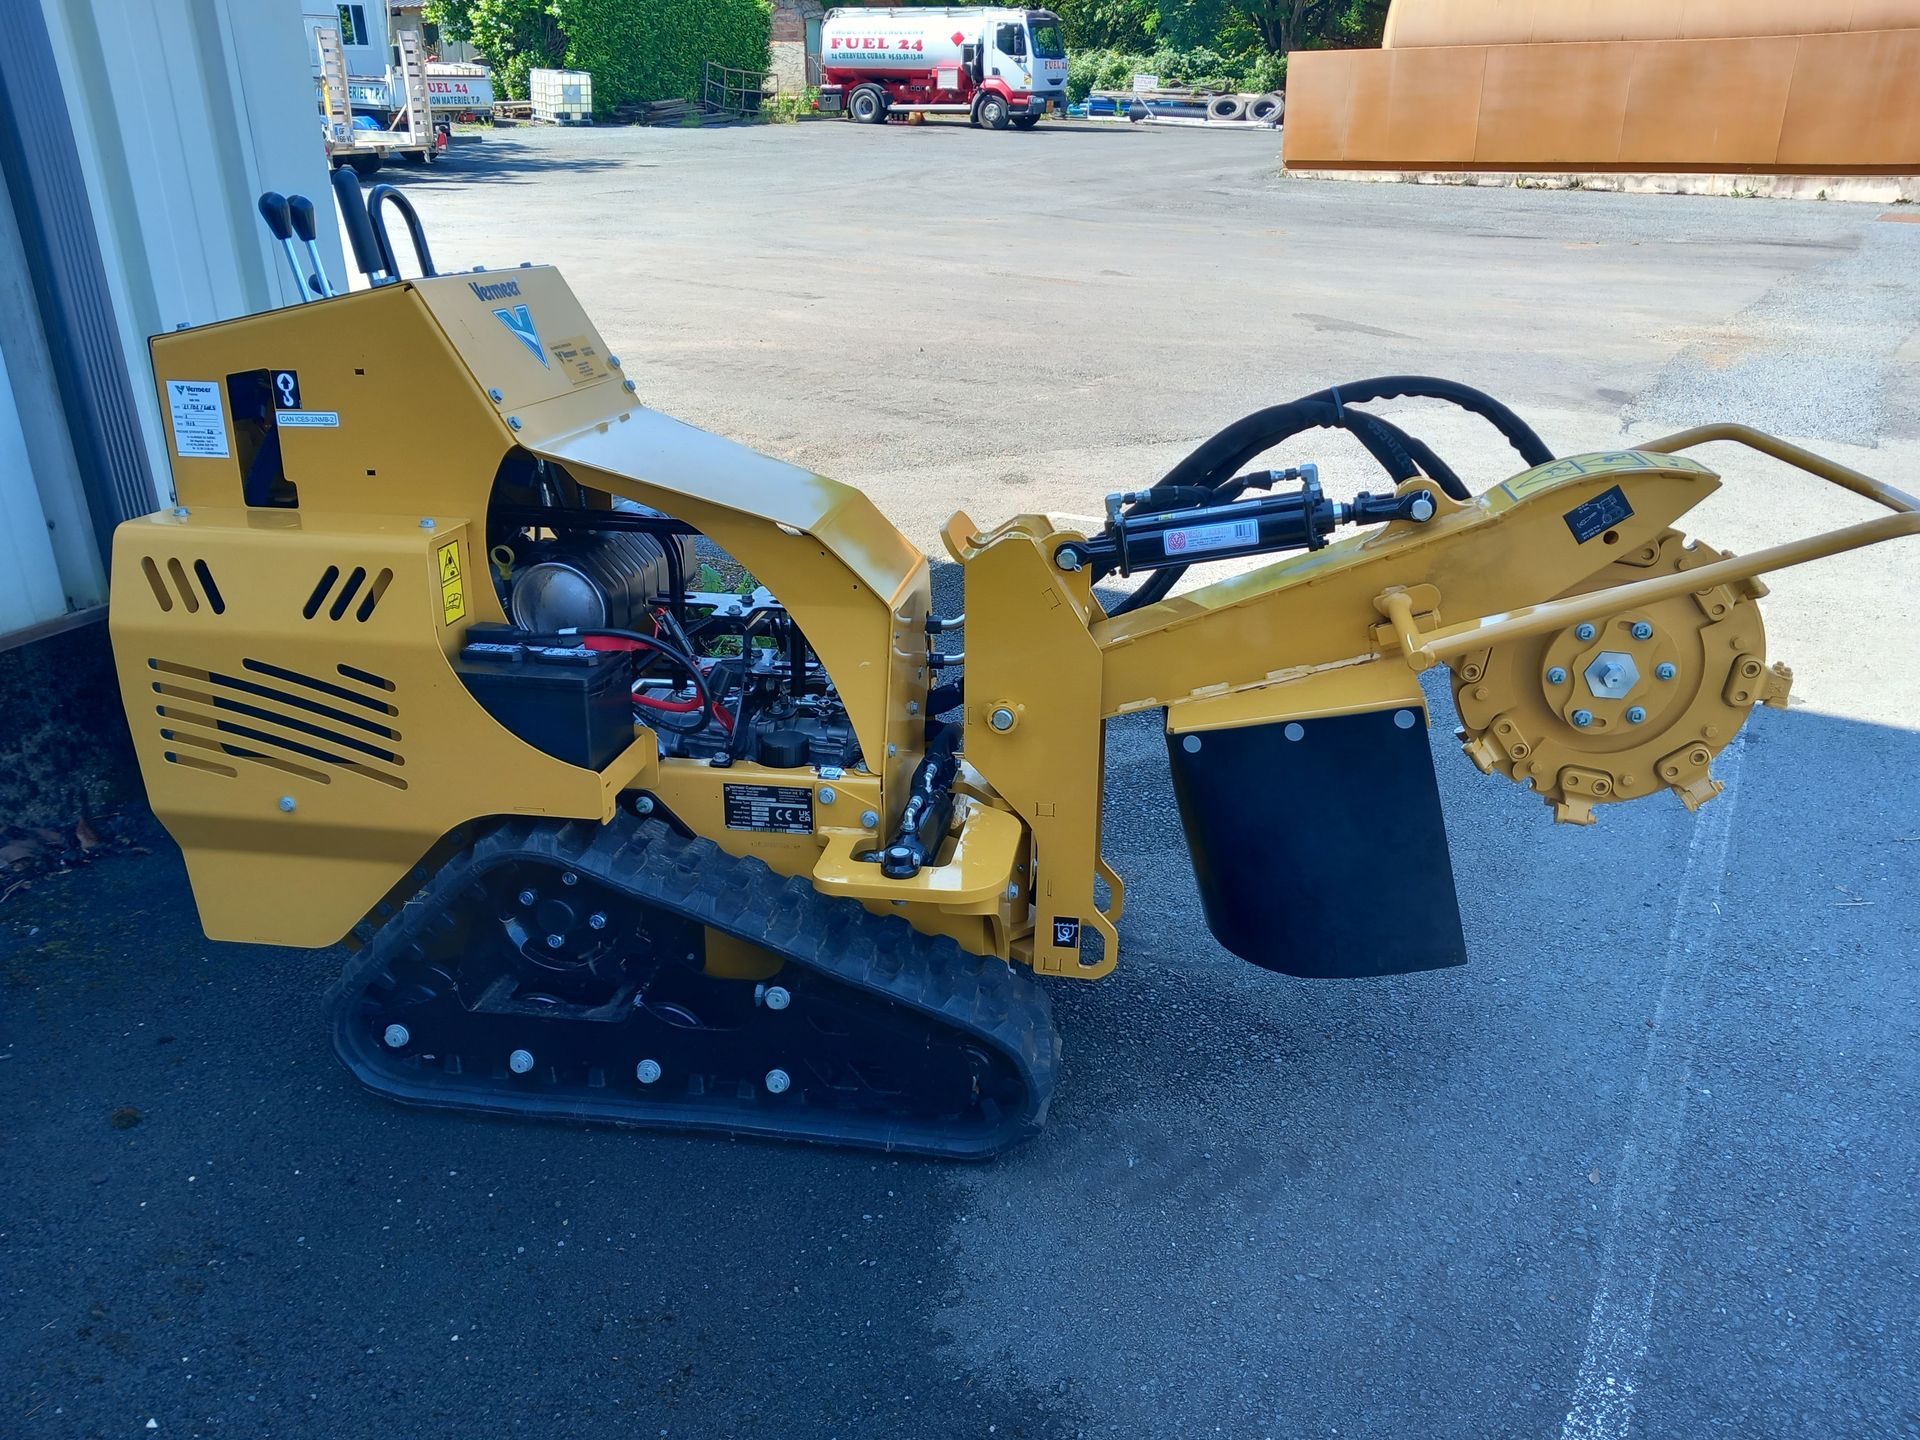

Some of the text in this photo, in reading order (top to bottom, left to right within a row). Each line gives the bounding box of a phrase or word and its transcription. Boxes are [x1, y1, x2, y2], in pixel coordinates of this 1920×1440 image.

[831, 37, 923, 51] FUEL 24
[428, 82, 468, 94] UEL 24
[442, 96, 470, 105] MATERIEL
[468, 280, 521, 302] Vermeer
[185, 385, 211, 393] Vermeer
